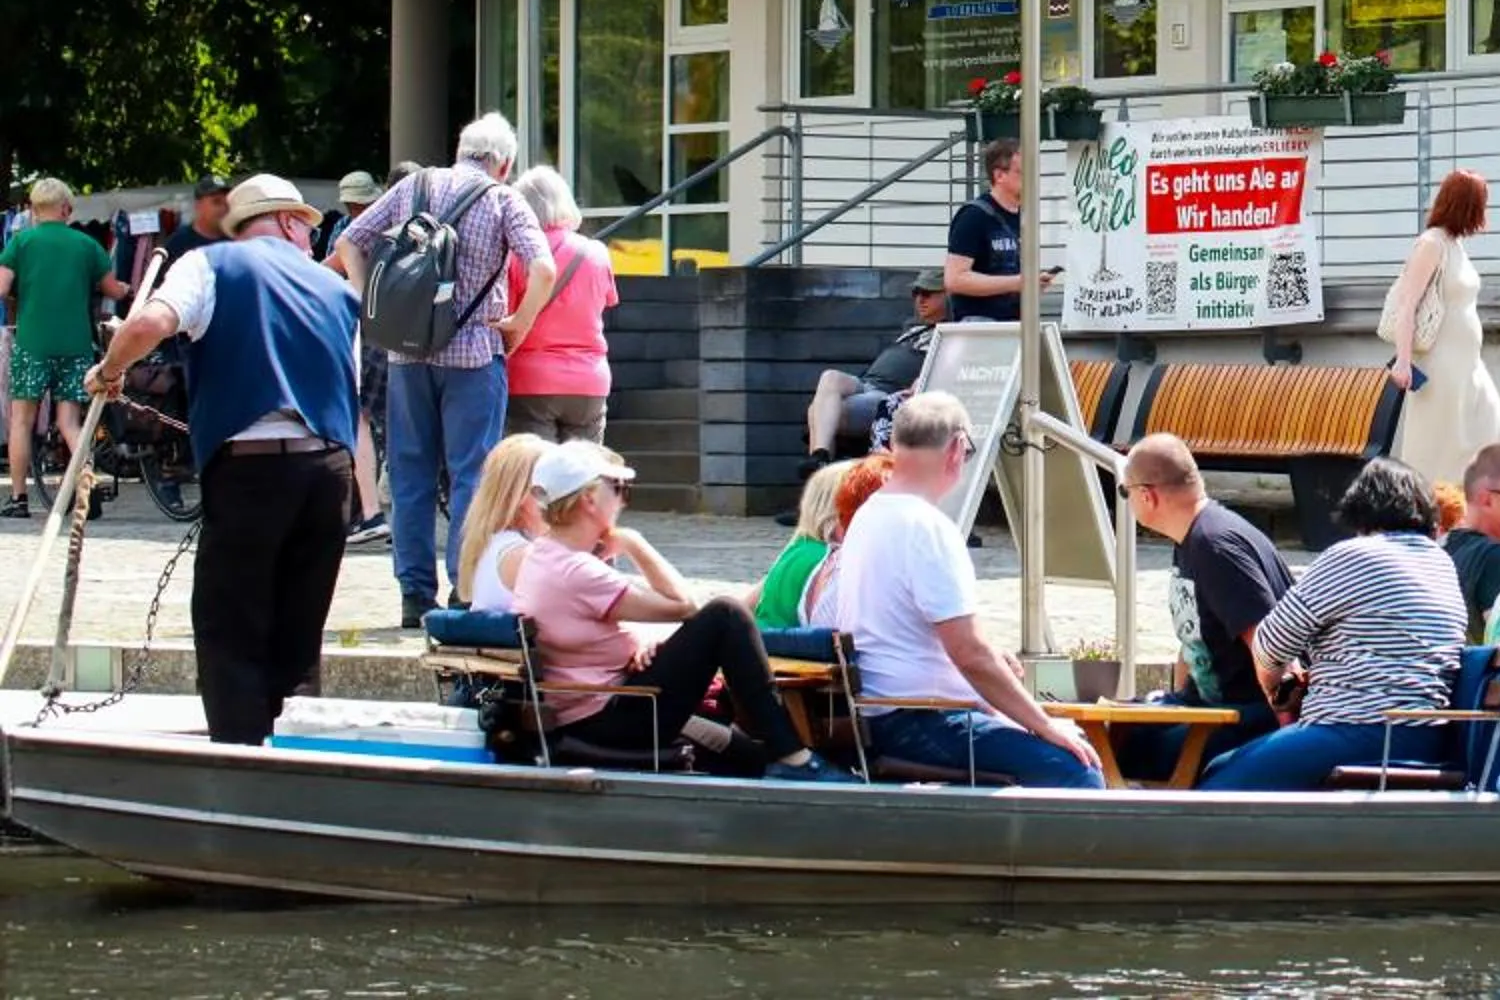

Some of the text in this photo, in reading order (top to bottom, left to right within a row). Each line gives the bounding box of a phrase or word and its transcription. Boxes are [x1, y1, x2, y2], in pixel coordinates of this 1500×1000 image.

[1150, 172, 1169, 195] Es
[1173, 168, 1211, 201] geht
[1214, 173, 1245, 192] uns
[1176, 201, 1278, 230] Wir handen!
[1190, 270, 1212, 291] als
